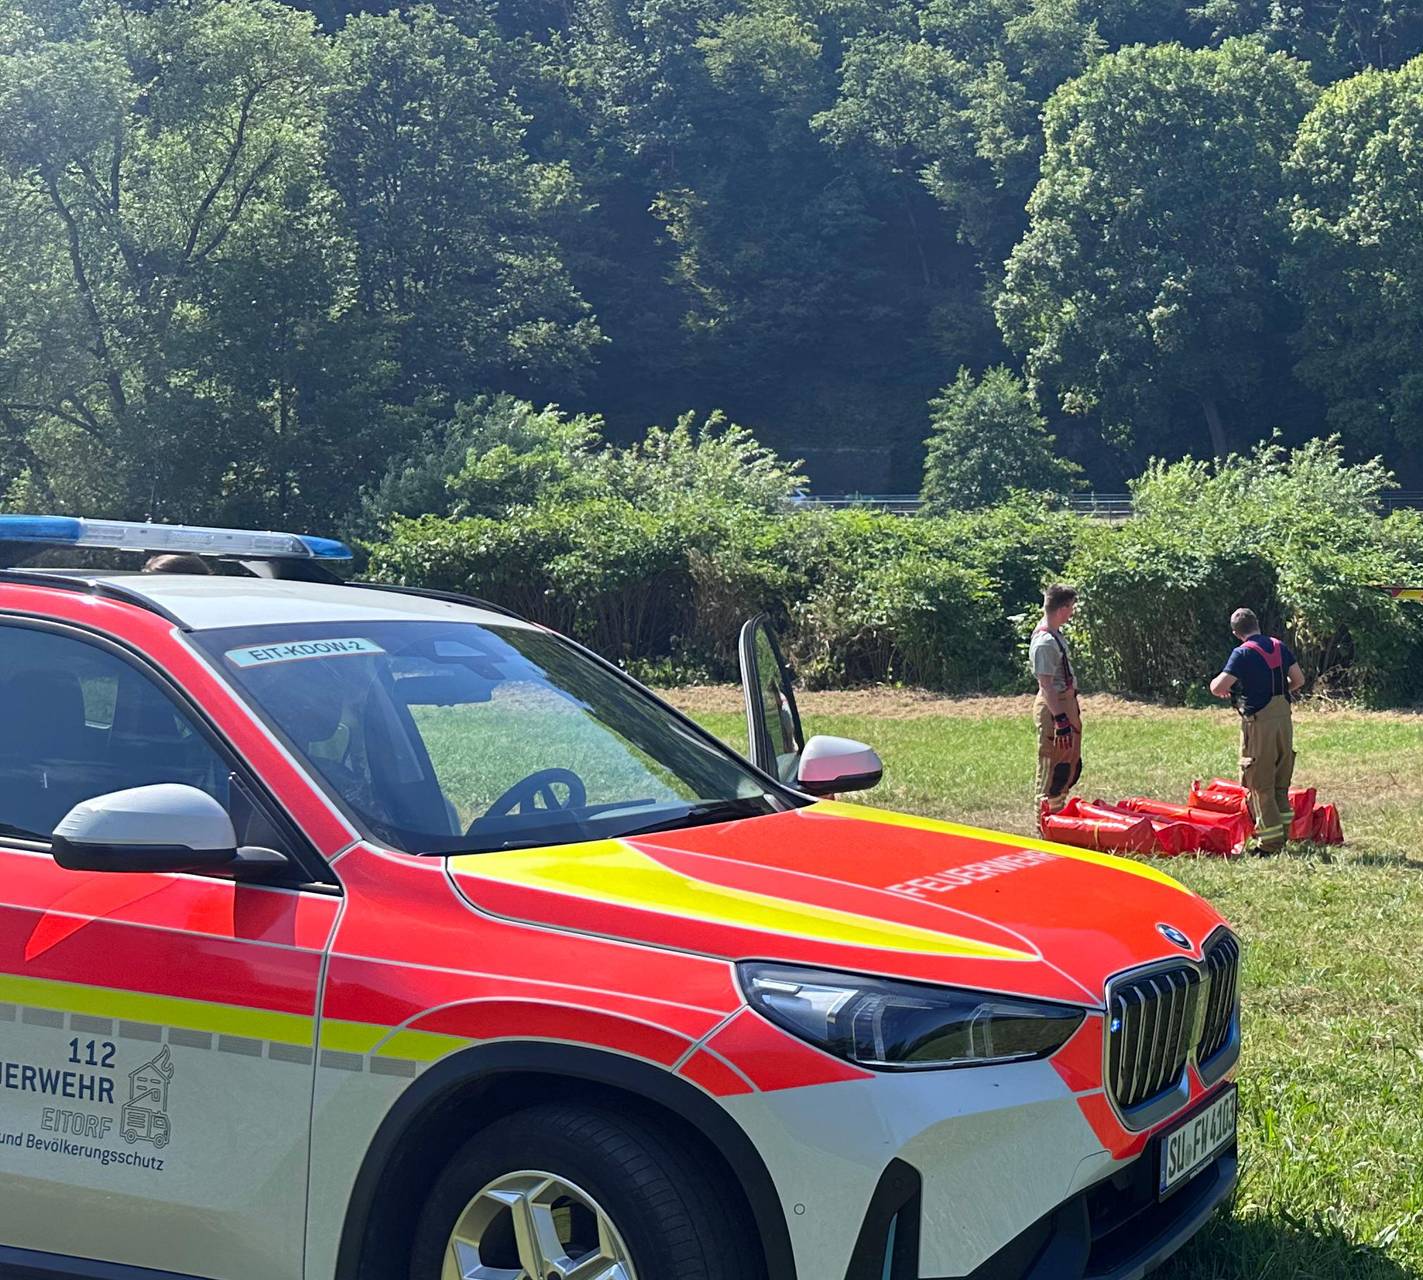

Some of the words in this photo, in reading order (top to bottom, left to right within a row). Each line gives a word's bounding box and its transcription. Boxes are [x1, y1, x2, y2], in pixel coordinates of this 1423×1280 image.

[248, 640, 366, 662] EIT-KDOW-2
[884, 850, 1066, 898] FEUERWEHR
[68, 1037, 117, 1069] 112
[0, 1061, 115, 1104] ERWEHR
[40, 1107, 113, 1139] EITORF
[1168, 1130, 1186, 1179] SU
[1193, 1113, 1209, 1161] FW
[1210, 1092, 1236, 1145] 4103
[0, 1131, 24, 1147] und
[26, 1133, 165, 1172] Bevölkerungsschutz
